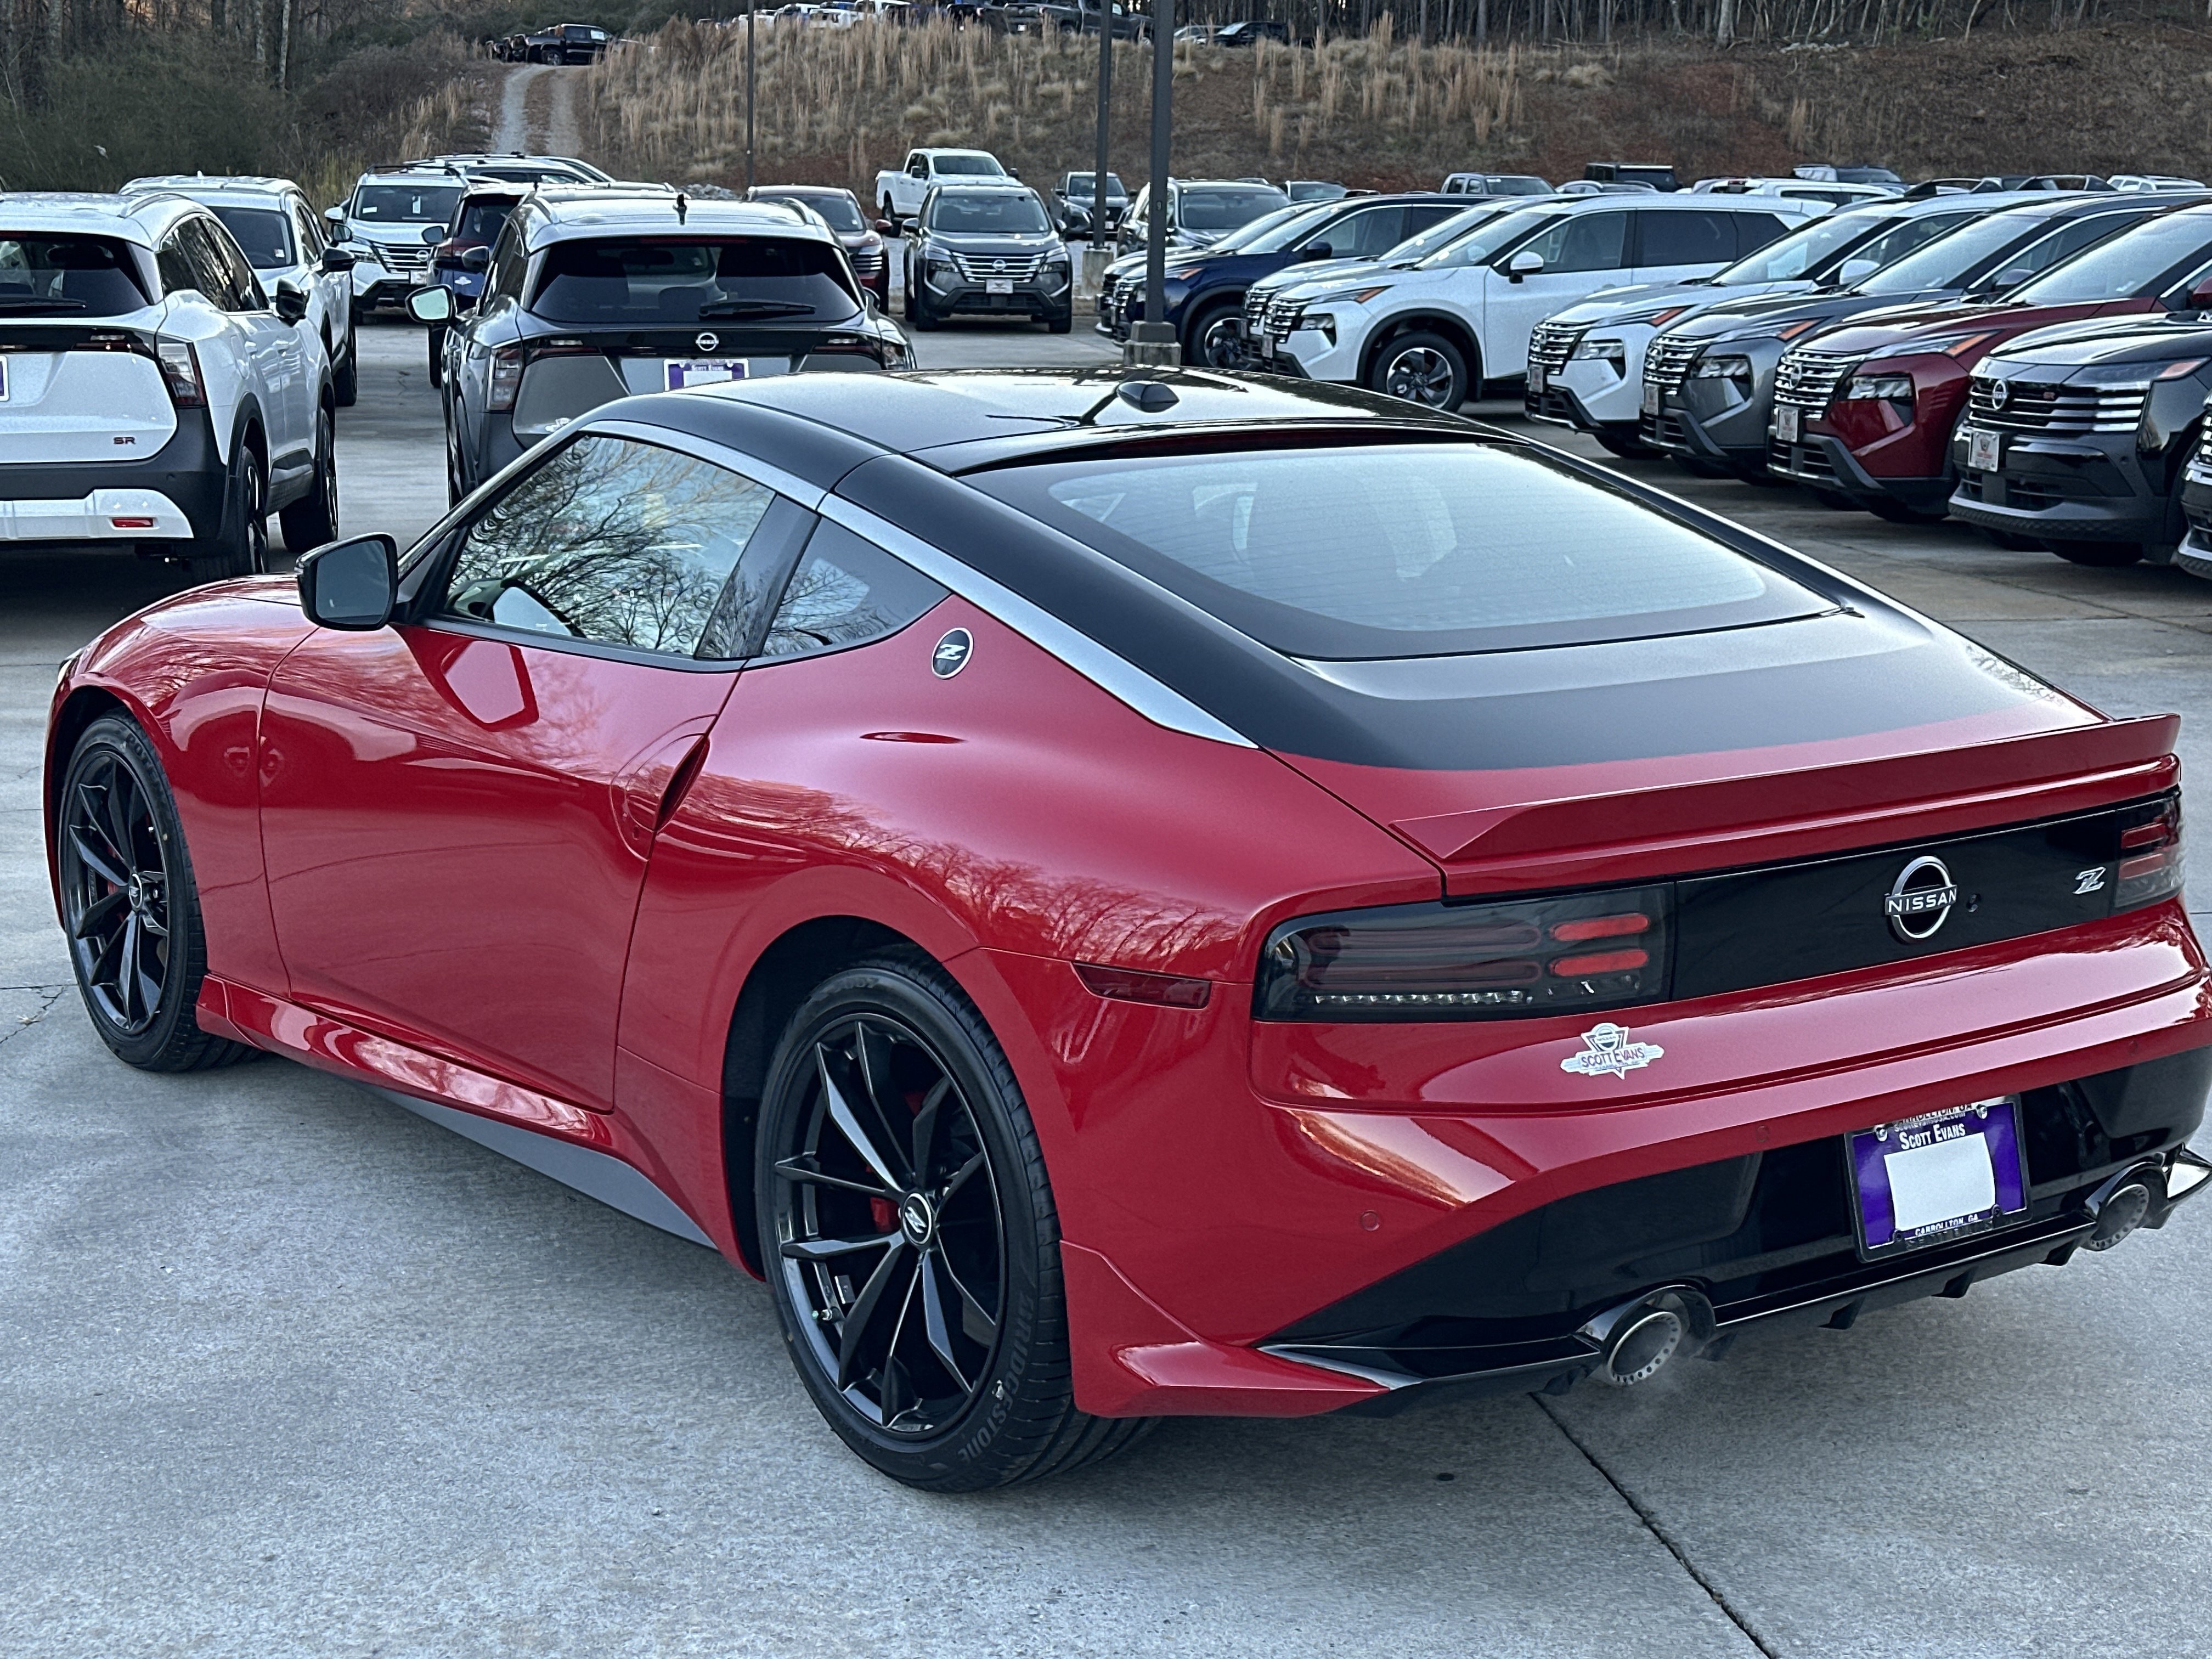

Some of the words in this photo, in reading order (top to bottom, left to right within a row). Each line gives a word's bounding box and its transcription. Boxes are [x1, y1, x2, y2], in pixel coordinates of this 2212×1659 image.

[2073, 866, 2106, 894] Z
[1888, 888, 1956, 912] NISSAN
[1581, 1052, 1612, 1068] SCOTT
[1613, 1047, 1645, 1063] EVANS
[1899, 1130, 1932, 1150] SCOTT
[1933, 1123, 1966, 1143] EVANS
